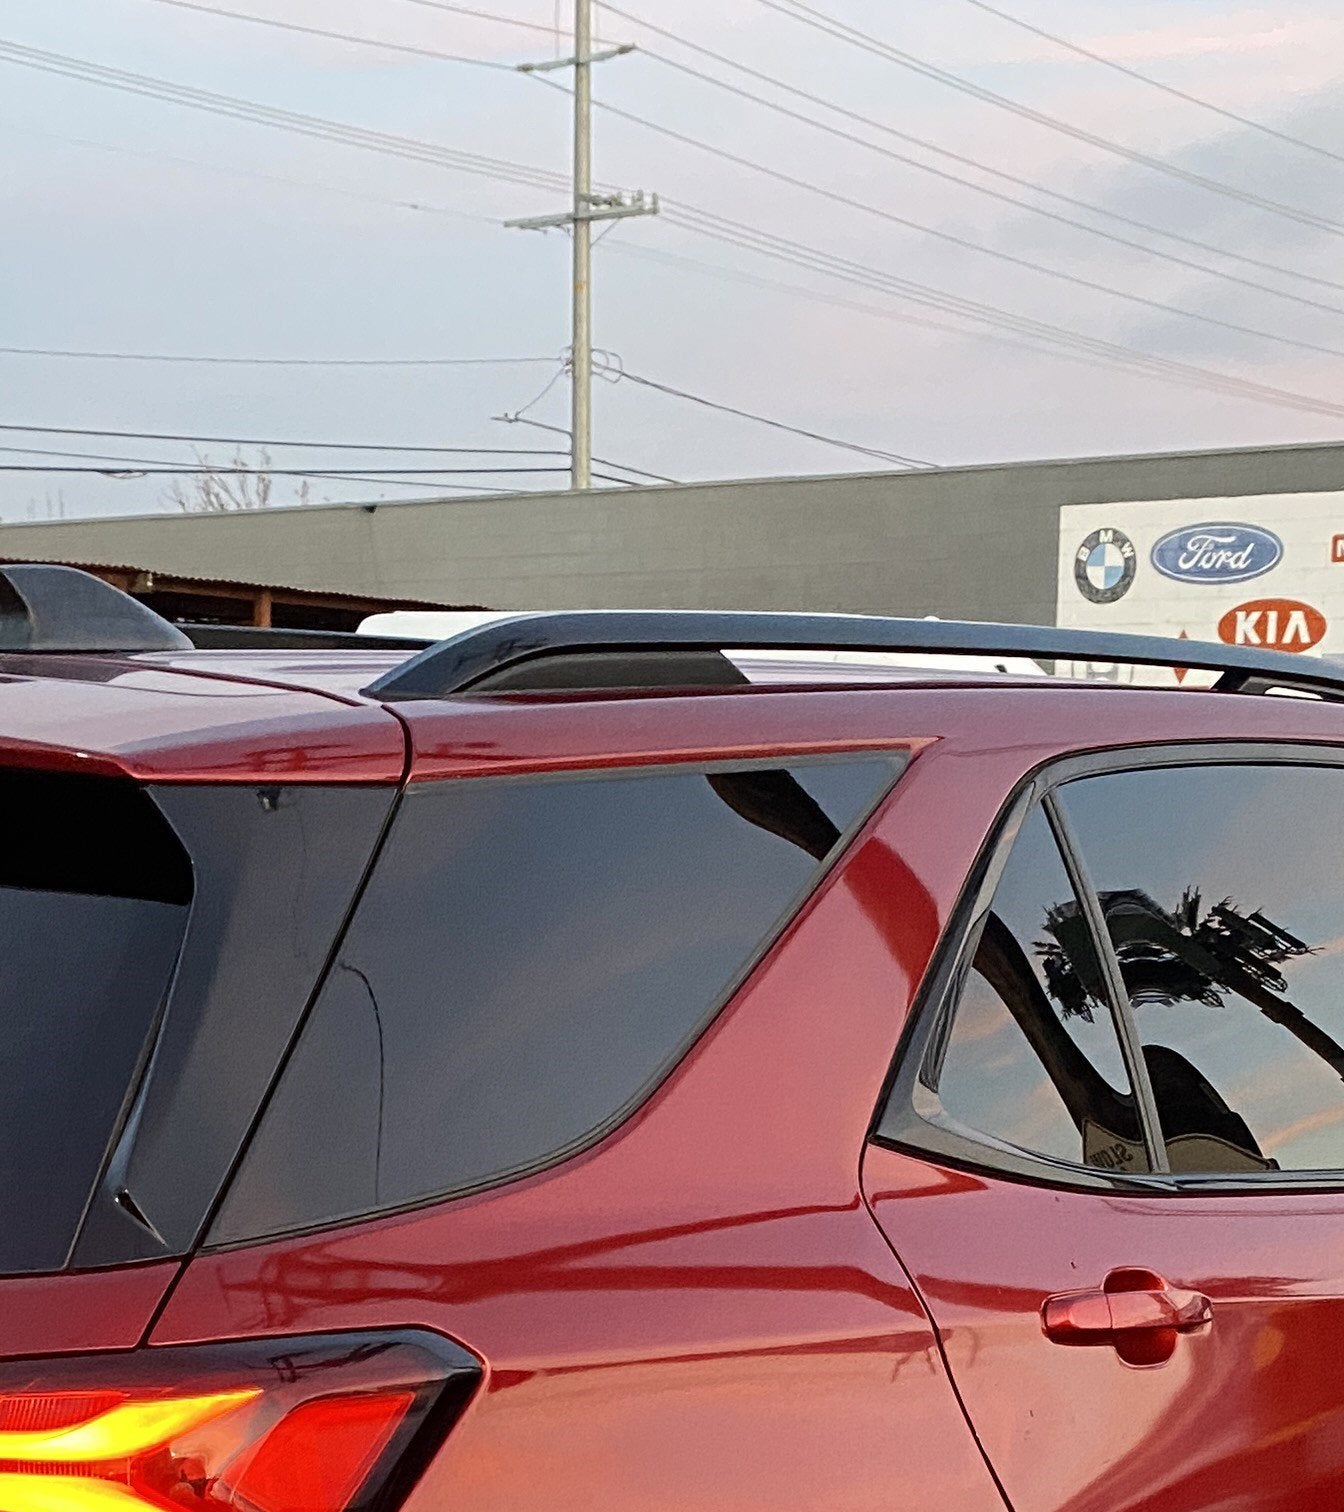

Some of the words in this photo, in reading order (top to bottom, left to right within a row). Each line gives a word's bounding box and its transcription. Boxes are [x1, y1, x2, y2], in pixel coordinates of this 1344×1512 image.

[1076, 529, 1134, 562] BMW
[1177, 534, 1255, 570] Ford
[1234, 610, 1311, 645] KIA
